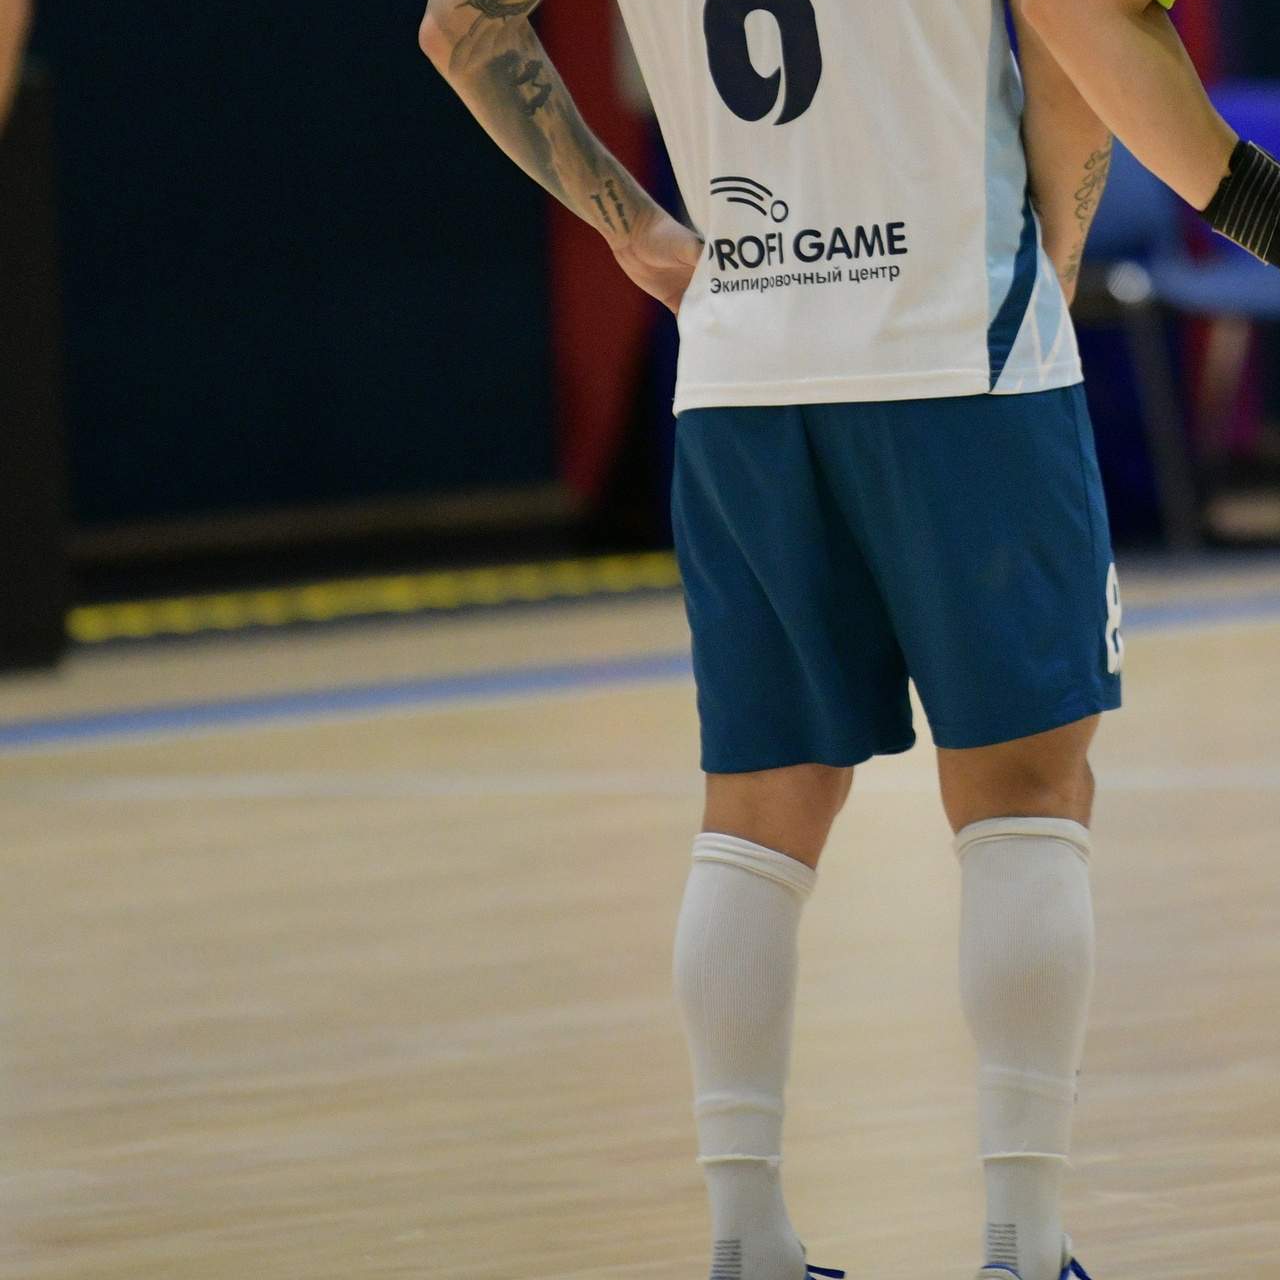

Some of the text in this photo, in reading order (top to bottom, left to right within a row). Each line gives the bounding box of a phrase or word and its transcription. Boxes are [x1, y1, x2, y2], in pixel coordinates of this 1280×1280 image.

[708, 221, 908, 271] ROFI GAME
[710, 265, 901, 294] Экипировочный центр
